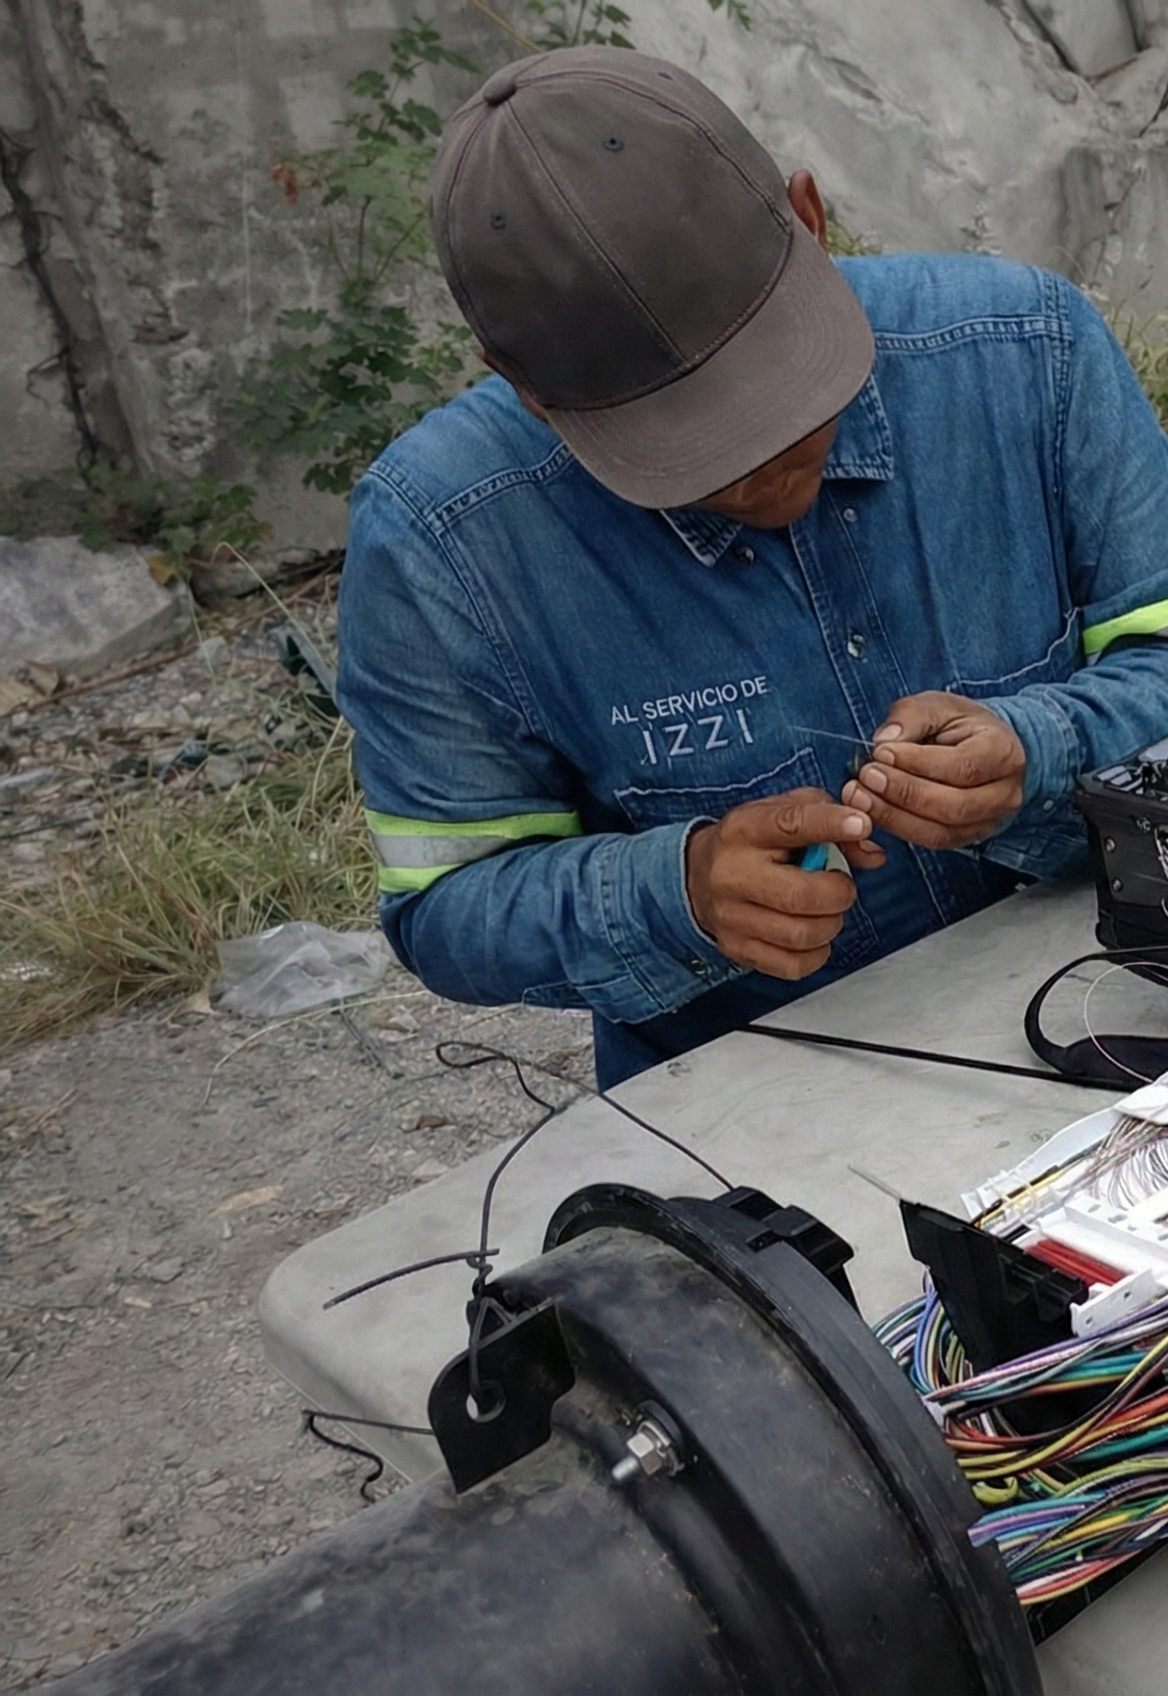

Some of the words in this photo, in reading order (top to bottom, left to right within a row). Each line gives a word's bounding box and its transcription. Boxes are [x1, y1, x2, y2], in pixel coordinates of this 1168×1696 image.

[611, 706, 639, 726] AL
[642, 684, 738, 720] SERVICIO
[740, 676, 768, 698] DE
[643, 709, 754, 765] IZZI
